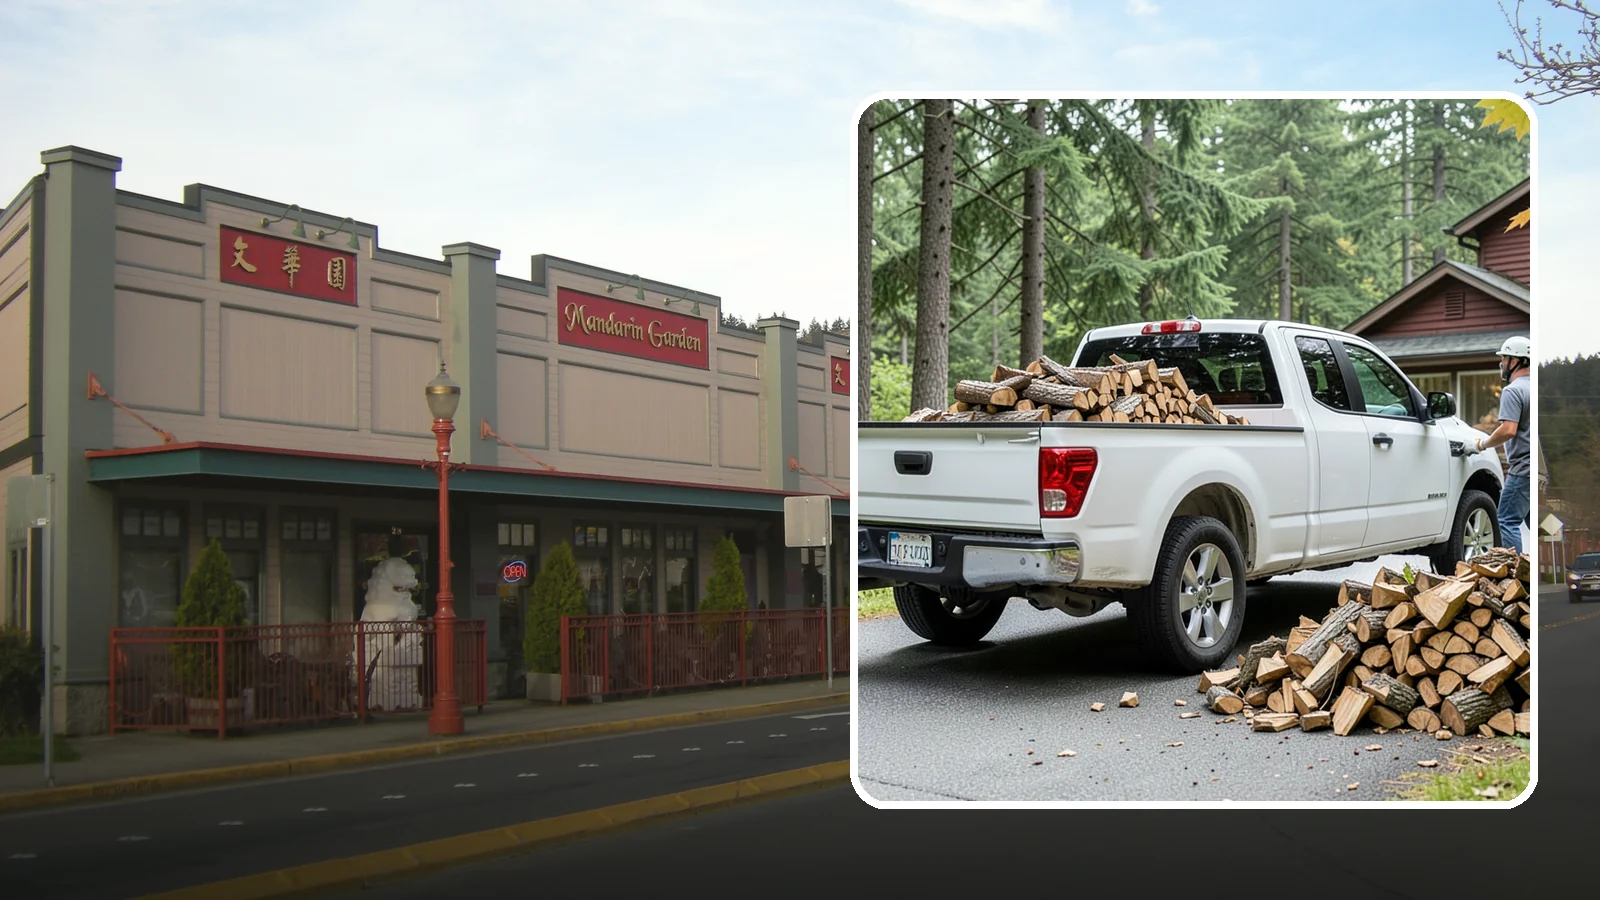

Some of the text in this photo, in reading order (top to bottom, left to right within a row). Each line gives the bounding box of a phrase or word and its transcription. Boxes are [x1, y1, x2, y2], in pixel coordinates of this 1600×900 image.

[231, 235, 347, 290] 文華園
[563, 302, 703, 352] Mandarin Garden
[503, 565, 526, 578] OPEN
